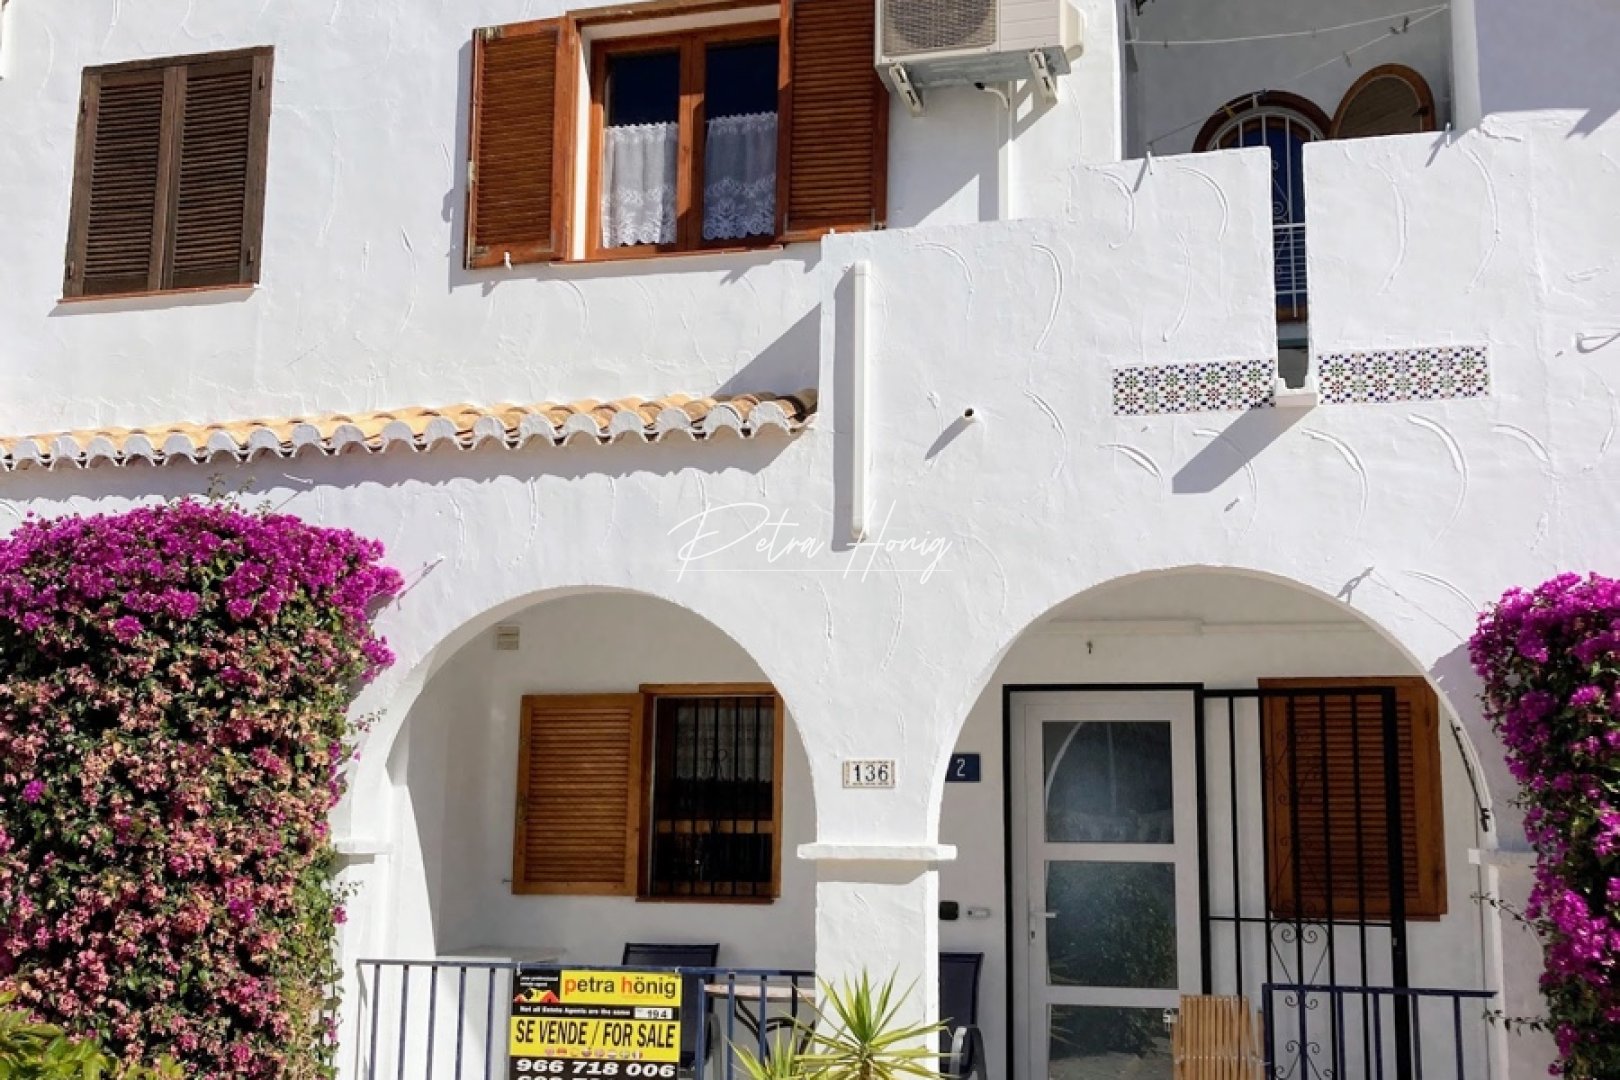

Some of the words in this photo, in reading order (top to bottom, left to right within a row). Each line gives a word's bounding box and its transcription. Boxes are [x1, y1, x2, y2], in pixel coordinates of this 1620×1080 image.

[853, 764, 889, 782] 136
[956, 758, 966, 777] 2
[564, 976, 615, 996] petra
[621, 976, 676, 999] hönig
[516, 1020, 535, 1043] SE
[539, 1021, 588, 1045] VENDE
[591, 1020, 600, 1046] /
[602, 1023, 633, 1047] FOR
[637, 1024, 676, 1049] SALE
[516, 1058, 565, 1073] 966
[571, 1061, 620, 1076] 718
[626, 1063, 676, 1078] 006
